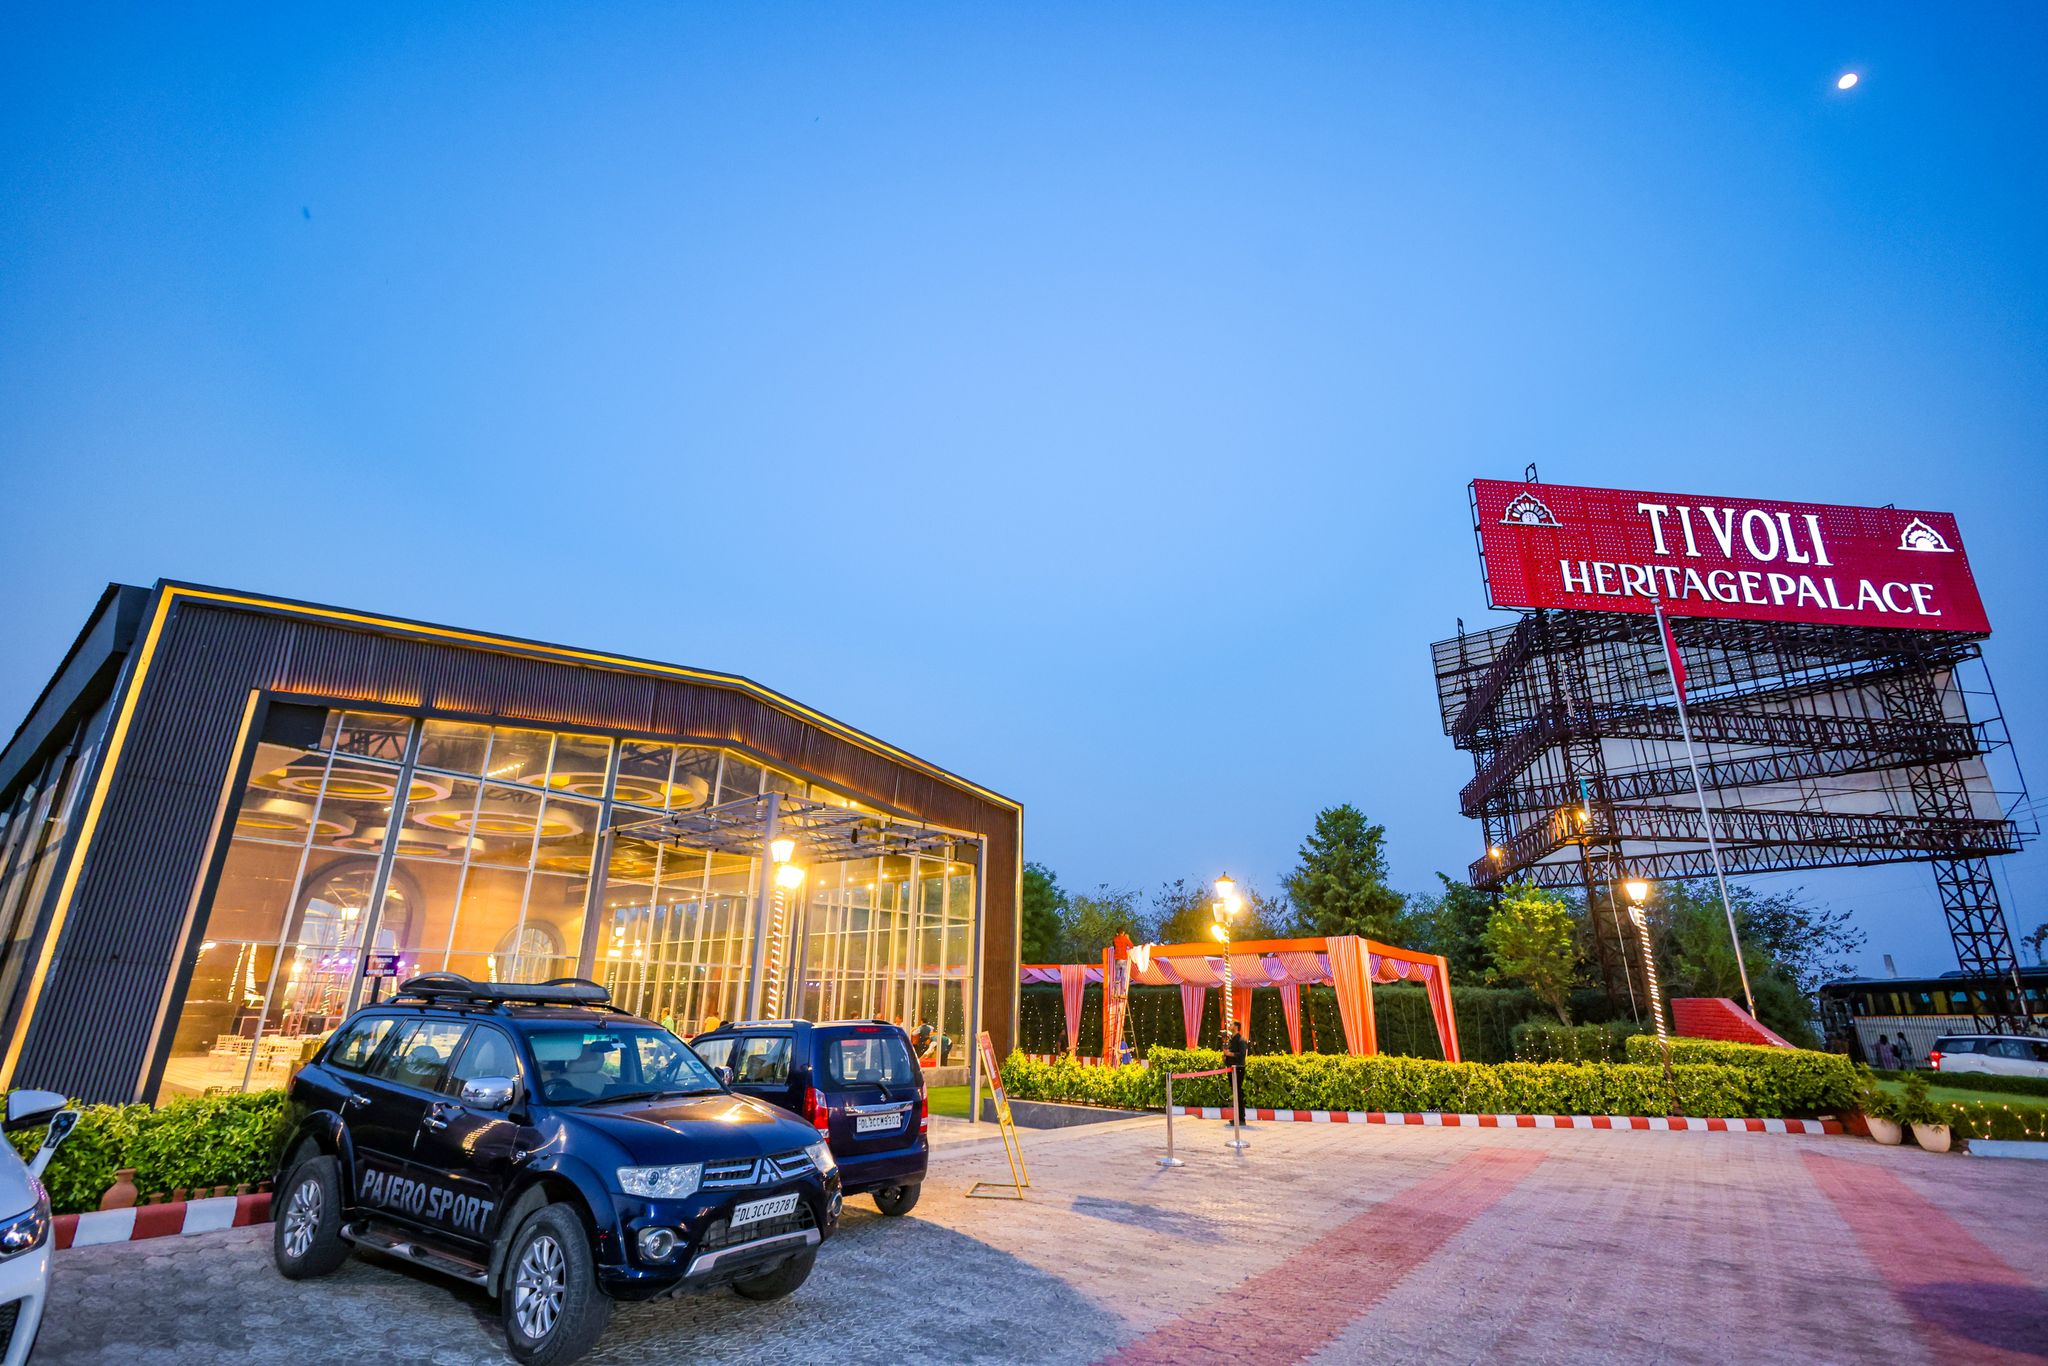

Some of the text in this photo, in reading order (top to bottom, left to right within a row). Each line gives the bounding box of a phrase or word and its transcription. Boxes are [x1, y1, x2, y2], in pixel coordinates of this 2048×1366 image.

[1637, 502, 1834, 566] TIVOLI
[360, 1169, 494, 1233] PAJERO SPORT
[739, 1198, 797, 1222] DL3CCP3781
